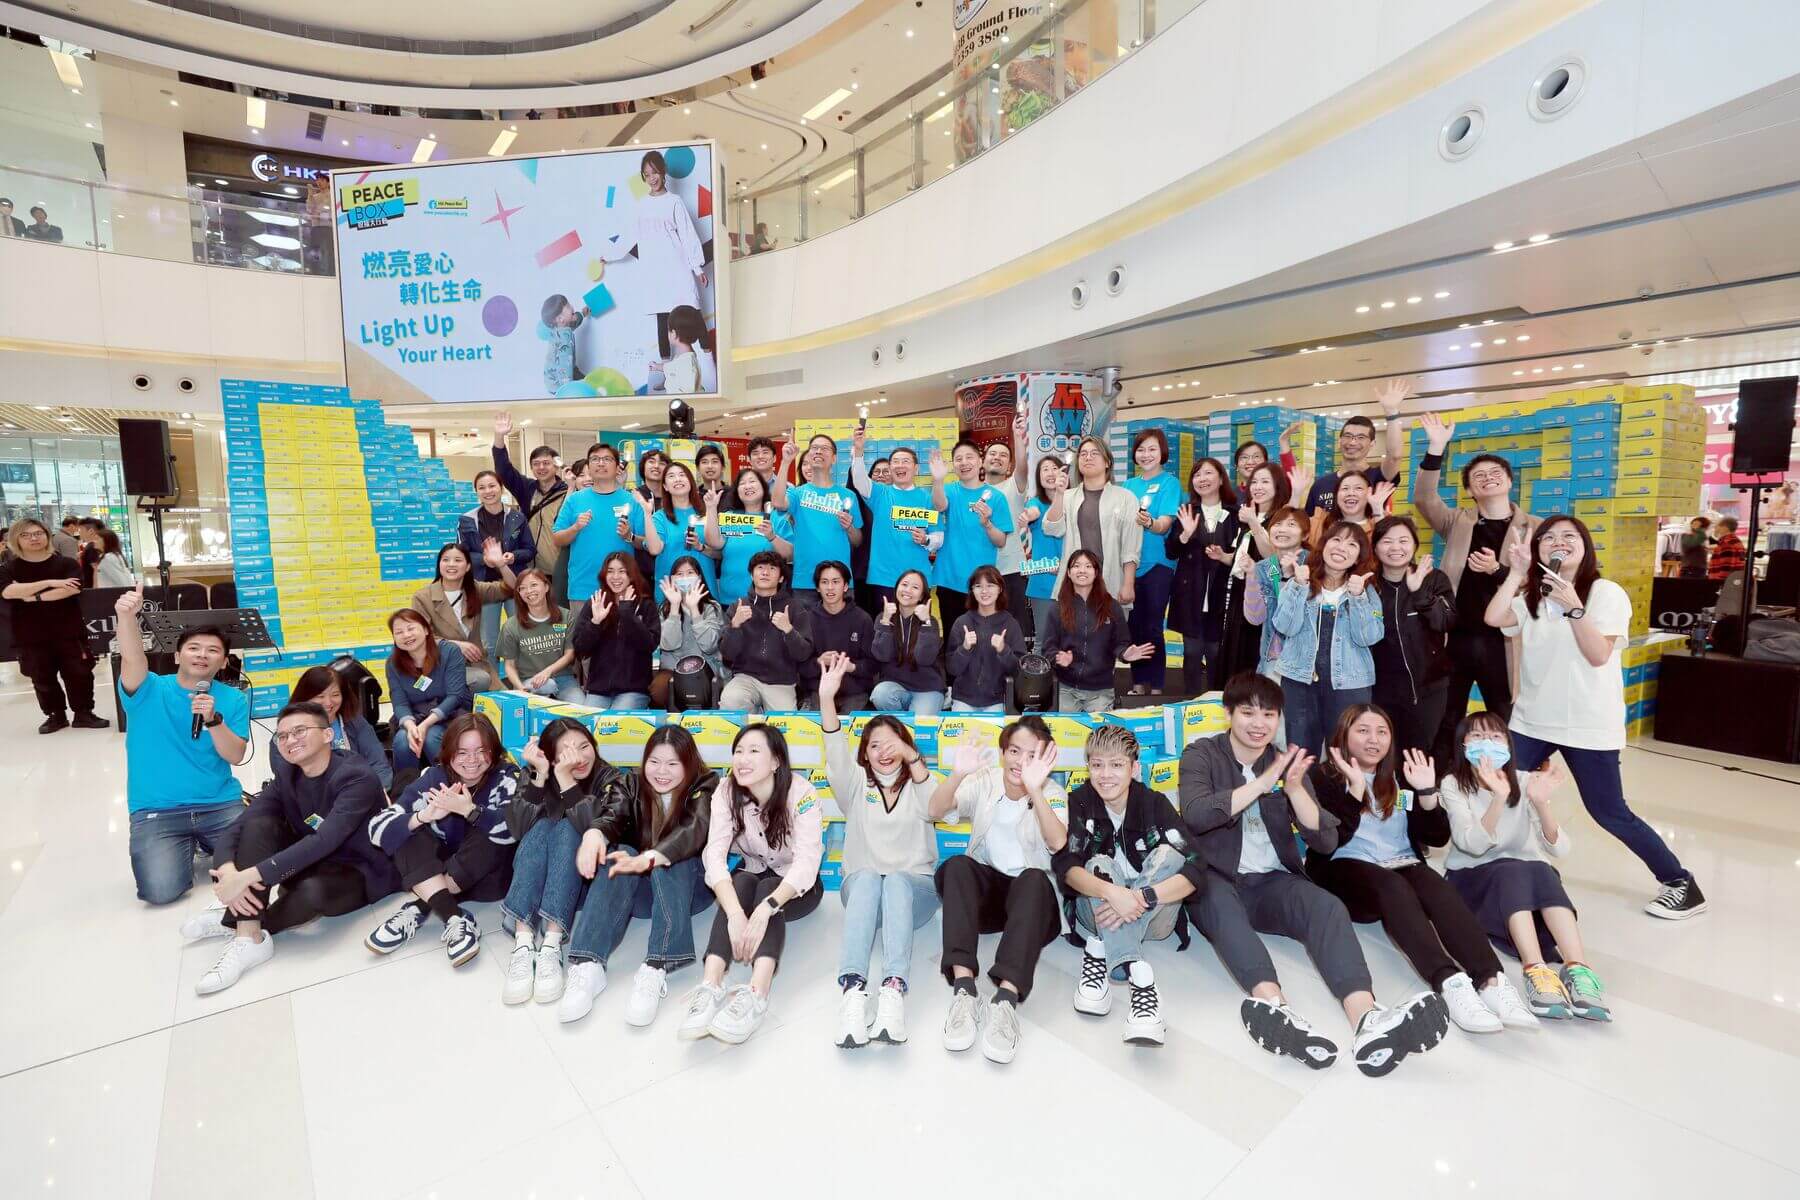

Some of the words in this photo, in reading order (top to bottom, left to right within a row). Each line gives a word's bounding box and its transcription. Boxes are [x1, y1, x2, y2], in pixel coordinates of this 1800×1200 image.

[967, 11, 1004, 40] Ground
[1009, 6, 1042, 20] Floor
[352, 182, 405, 204] PEACE
[355, 202, 388, 221] BOX
[362, 249, 454, 279] 燃亮愛心
[399, 278, 482, 305] 轉化生命
[360, 317, 418, 346] Light
[423, 314, 454, 337] Up
[398, 347, 437, 363] Your
[442, 344, 492, 361] Heart
[725, 515, 755, 525] PEACE
[898, 509, 930, 519] PEACE
